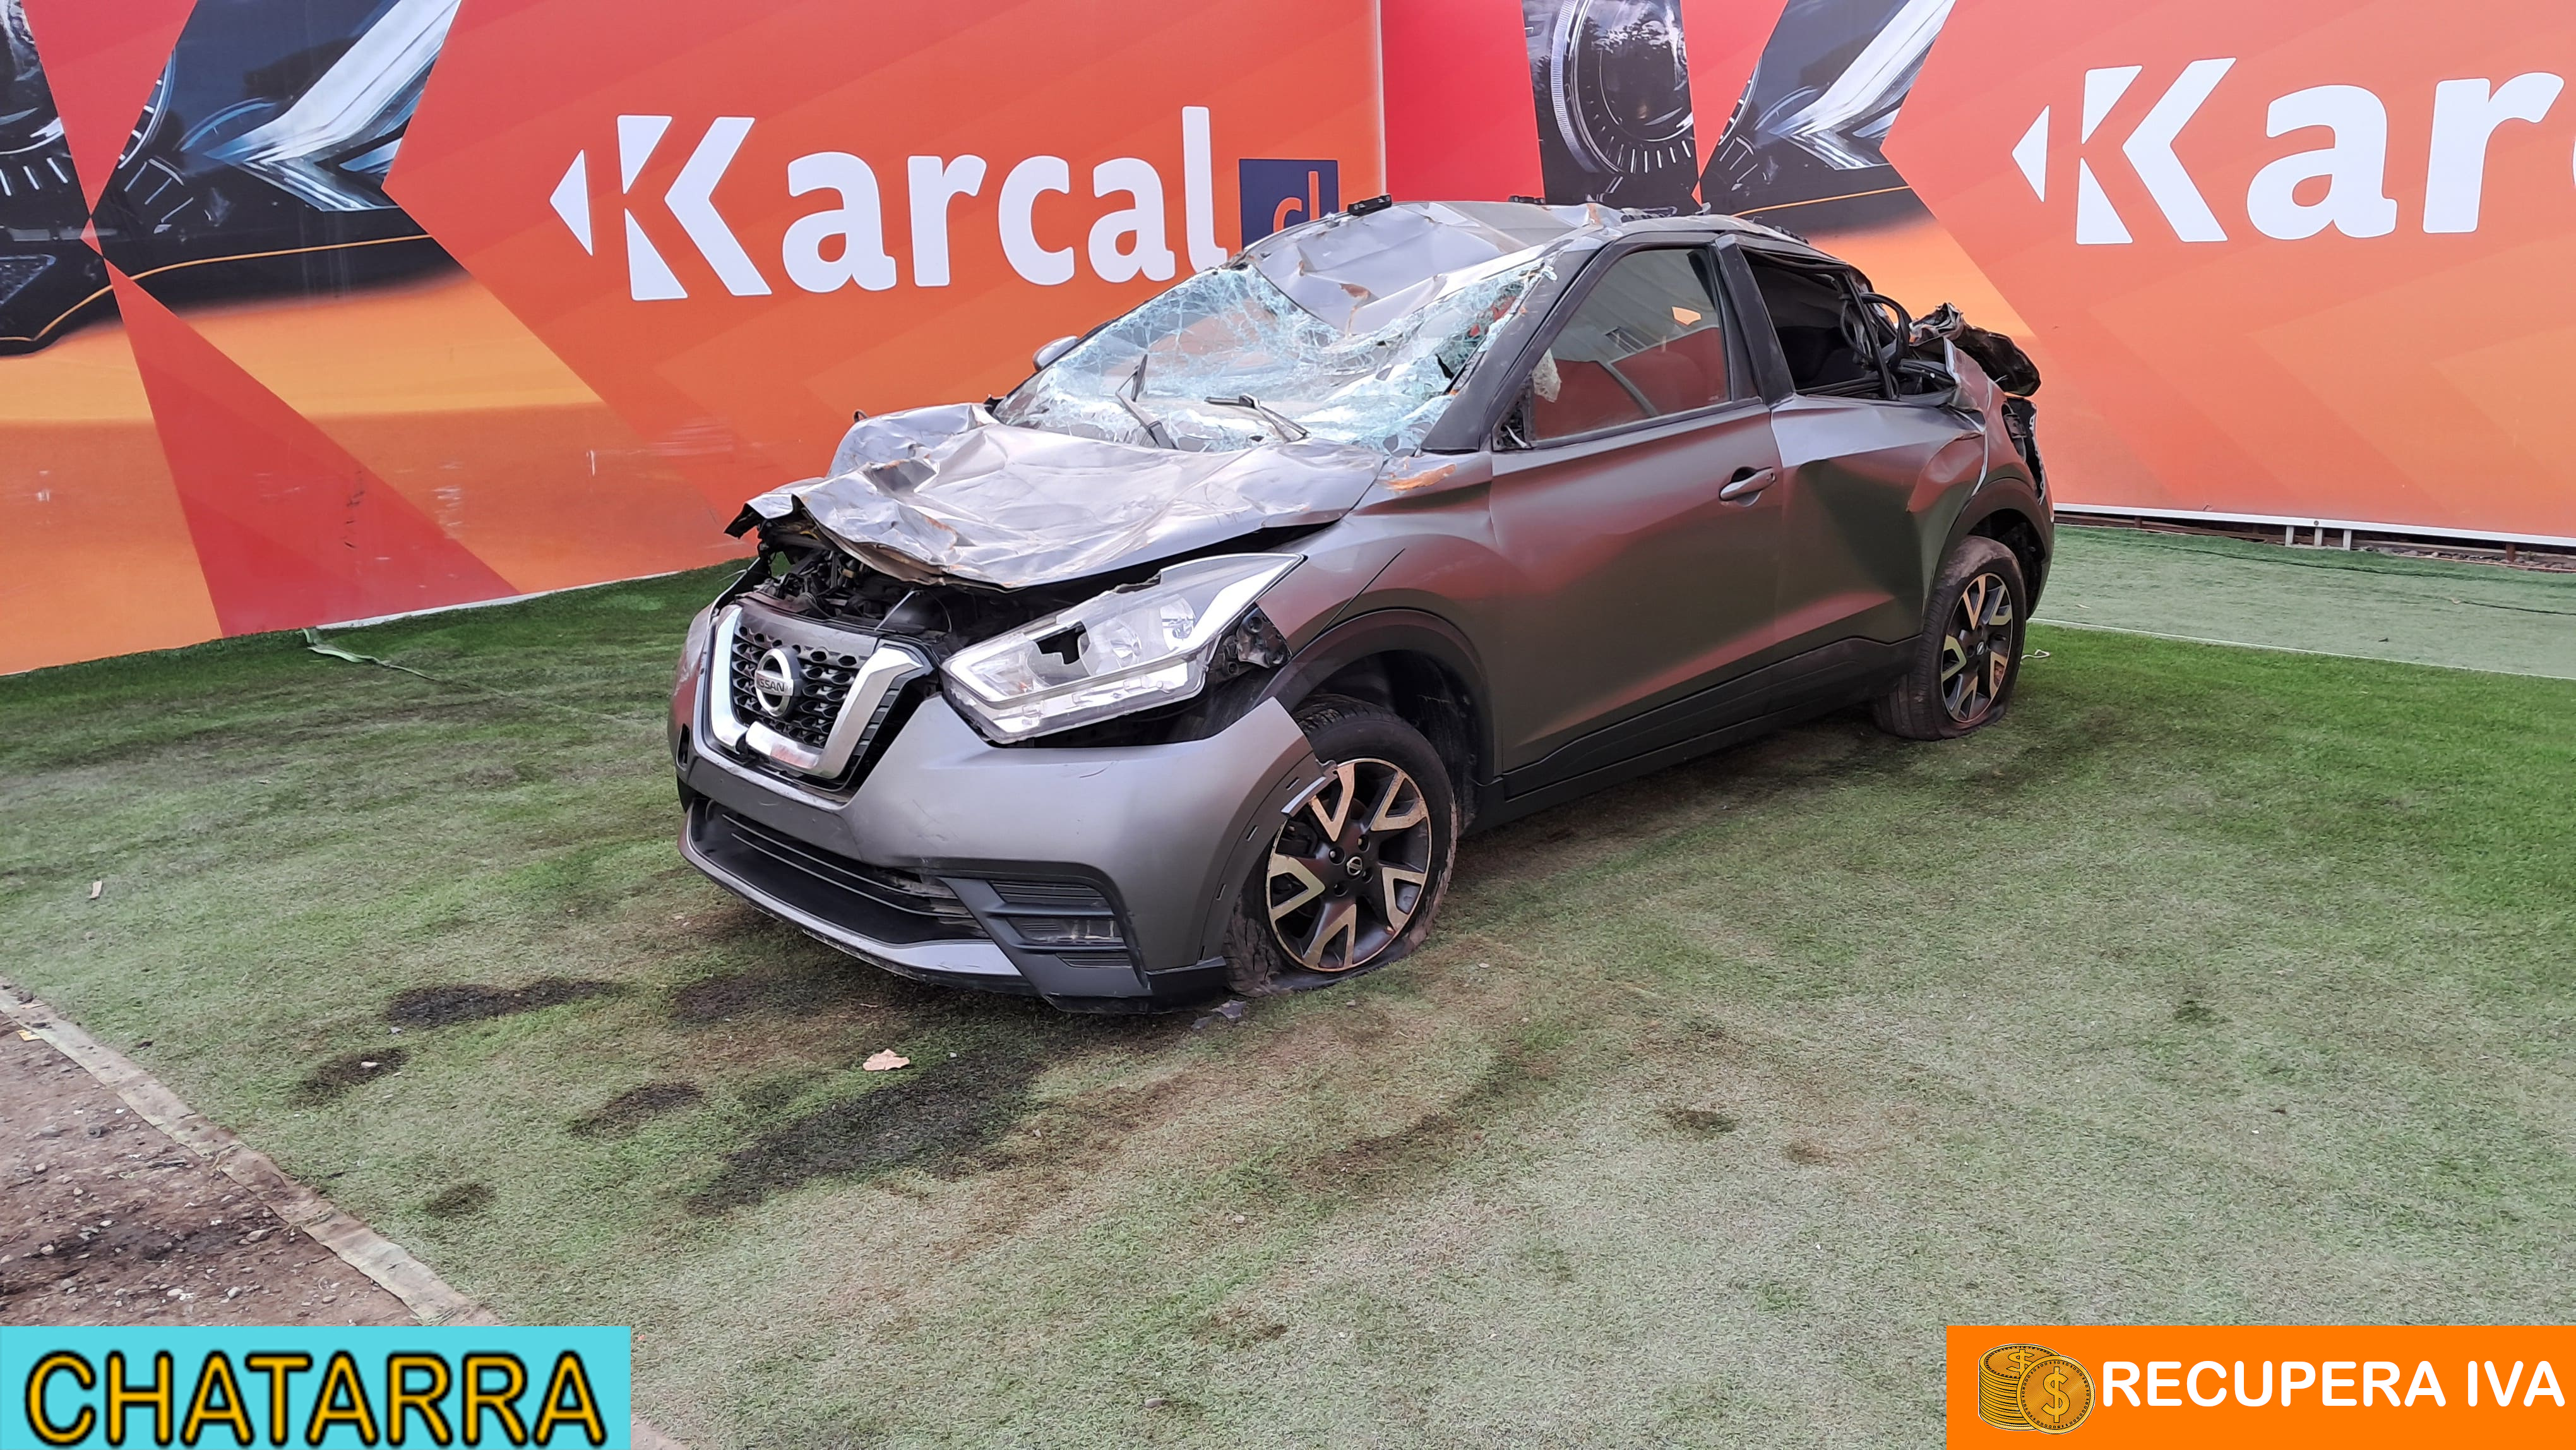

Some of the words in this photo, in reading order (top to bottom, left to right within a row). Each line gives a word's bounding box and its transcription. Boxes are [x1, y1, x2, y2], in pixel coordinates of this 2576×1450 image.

[617, 105, 1228, 301] Karcal
[2076, 57, 2576, 245] Kar
[757, 678, 784, 692] ISSAN
